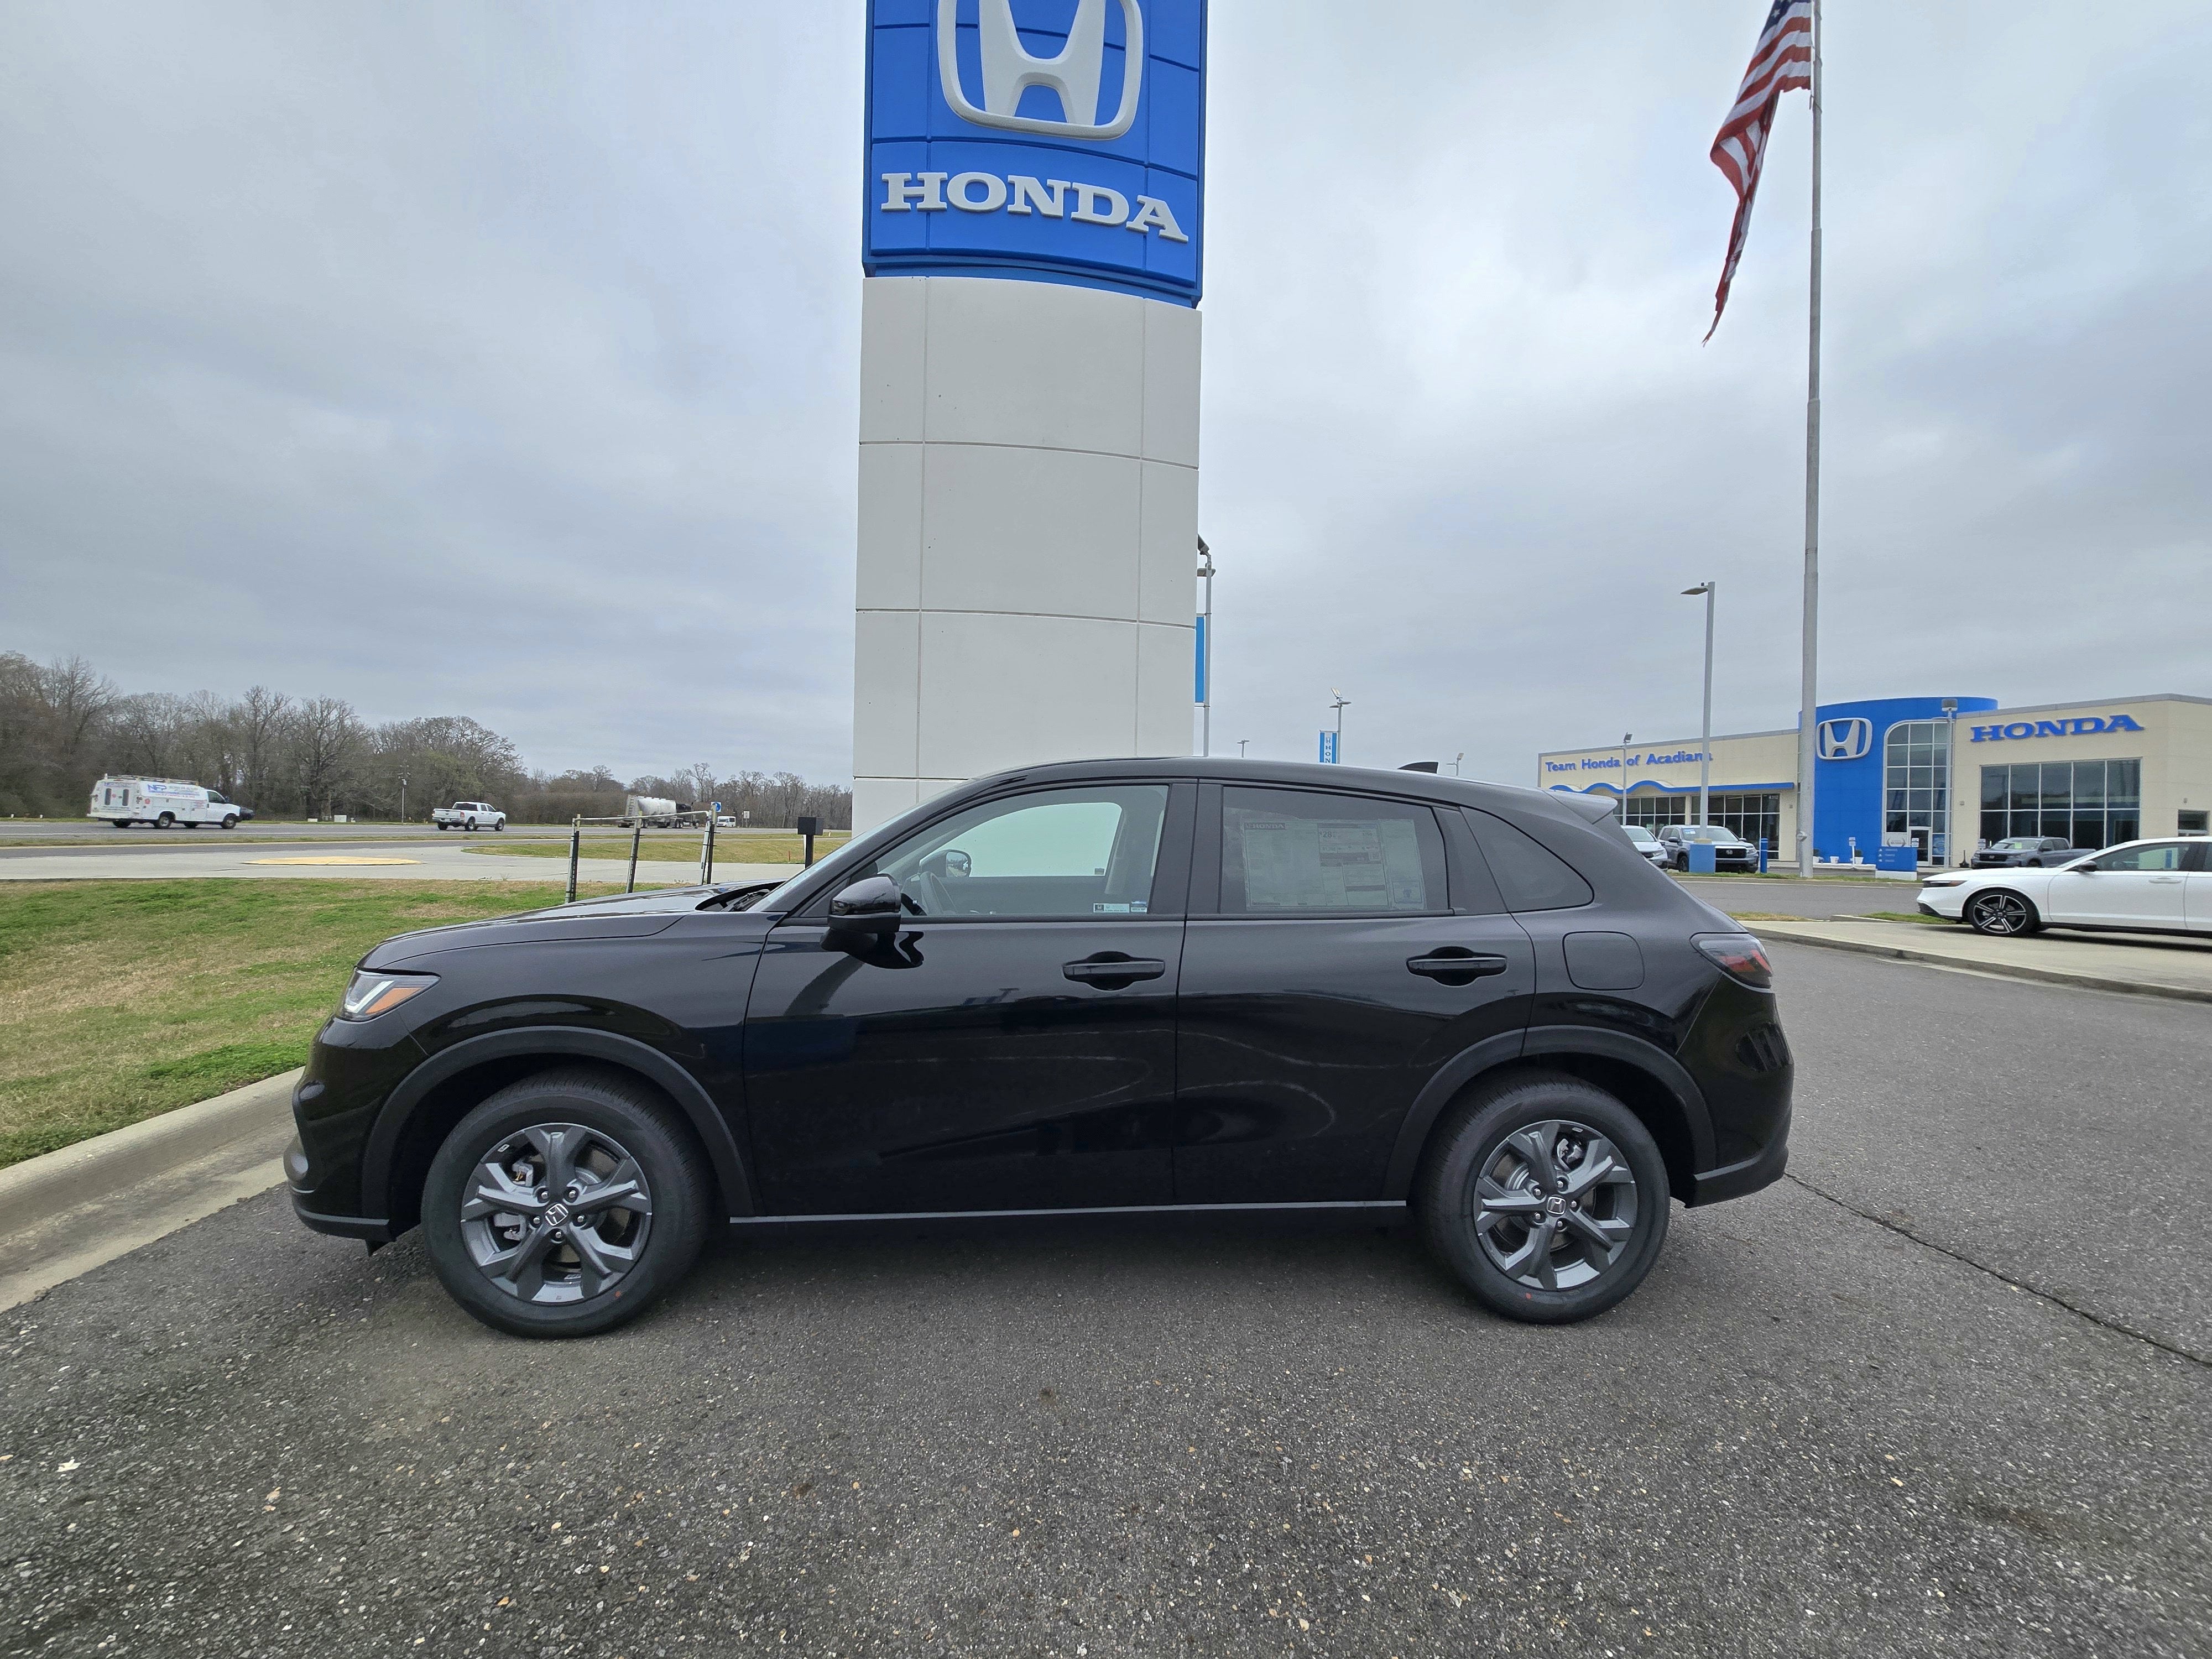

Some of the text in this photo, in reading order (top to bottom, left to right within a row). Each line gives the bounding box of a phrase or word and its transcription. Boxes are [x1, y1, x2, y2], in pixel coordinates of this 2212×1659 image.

[881, 172, 1189, 243] HONDA
[1970, 714, 2144, 742] HONDA
[1545, 761, 1577, 772] Team
[1581, 757, 1621, 770] Honda
[1626, 754, 1641, 766] of
